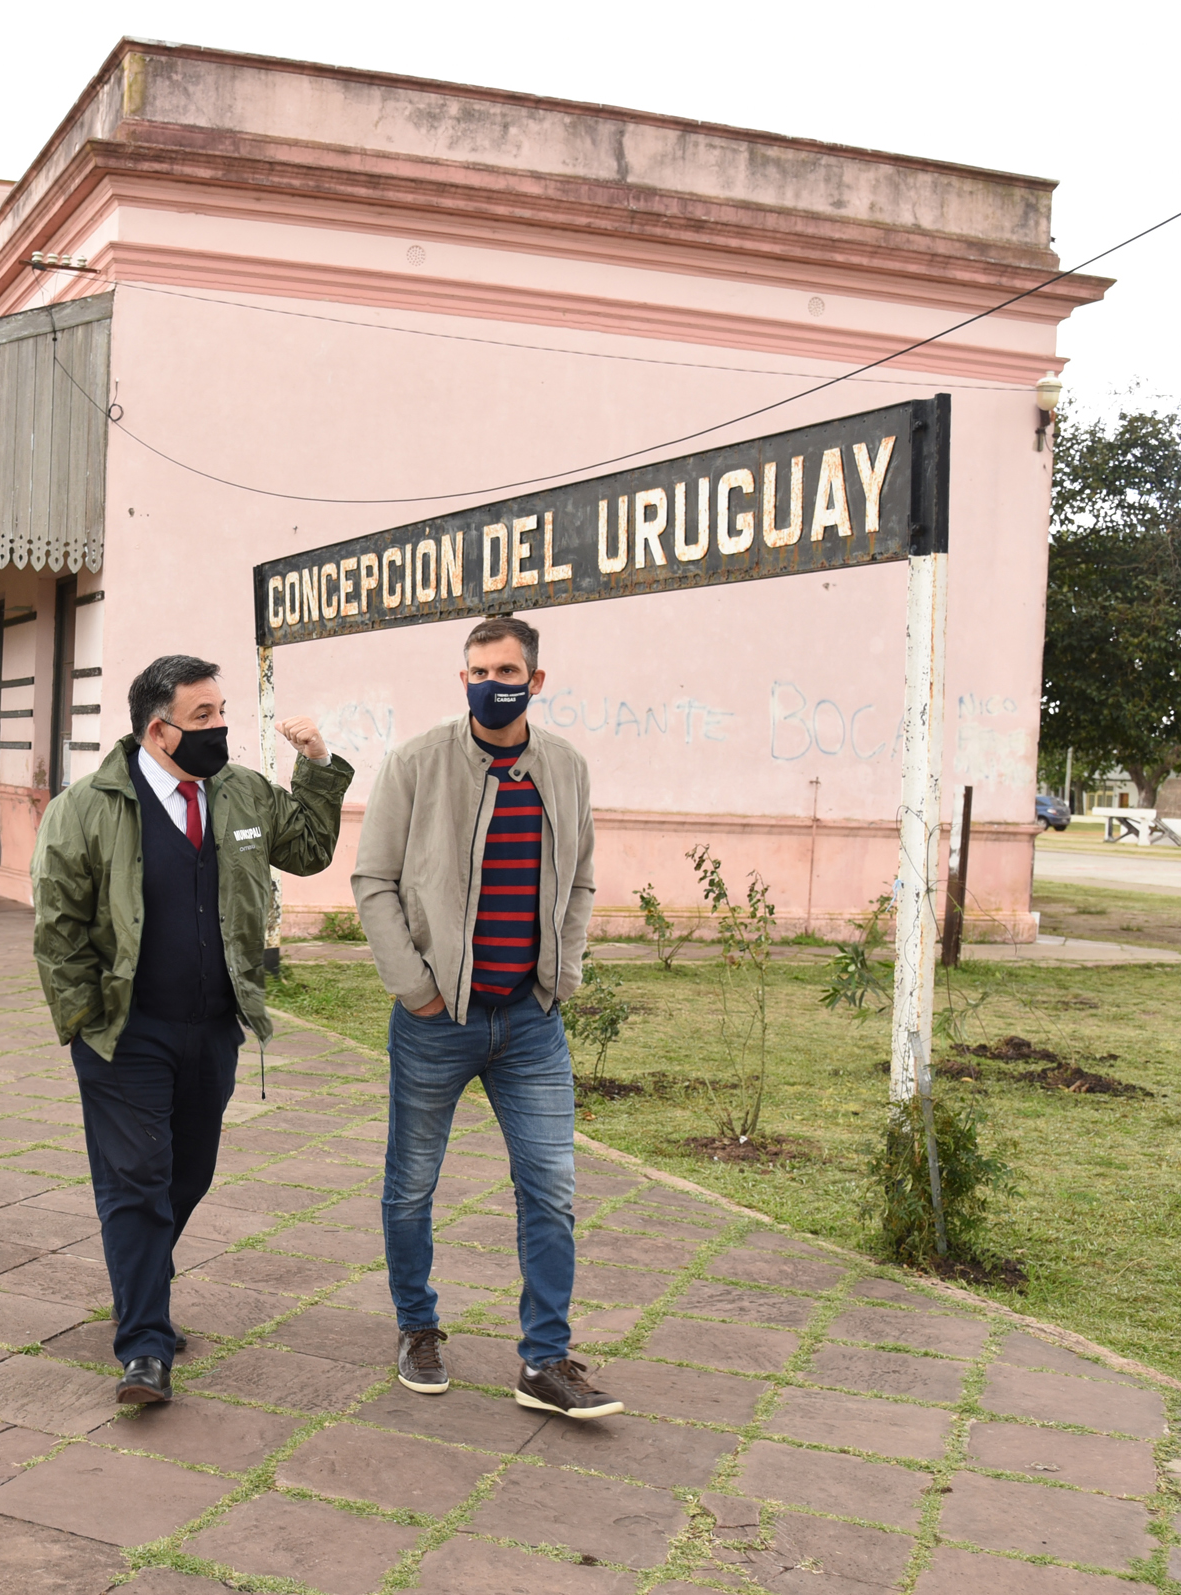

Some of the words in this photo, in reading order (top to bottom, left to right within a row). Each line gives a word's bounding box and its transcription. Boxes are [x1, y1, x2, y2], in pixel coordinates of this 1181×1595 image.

[268, 526, 464, 629] CONCEPCIÓN
[482, 511, 572, 593] DEL
[598, 435, 896, 574] URUGUAY
[958, 692, 1018, 719] NICO
